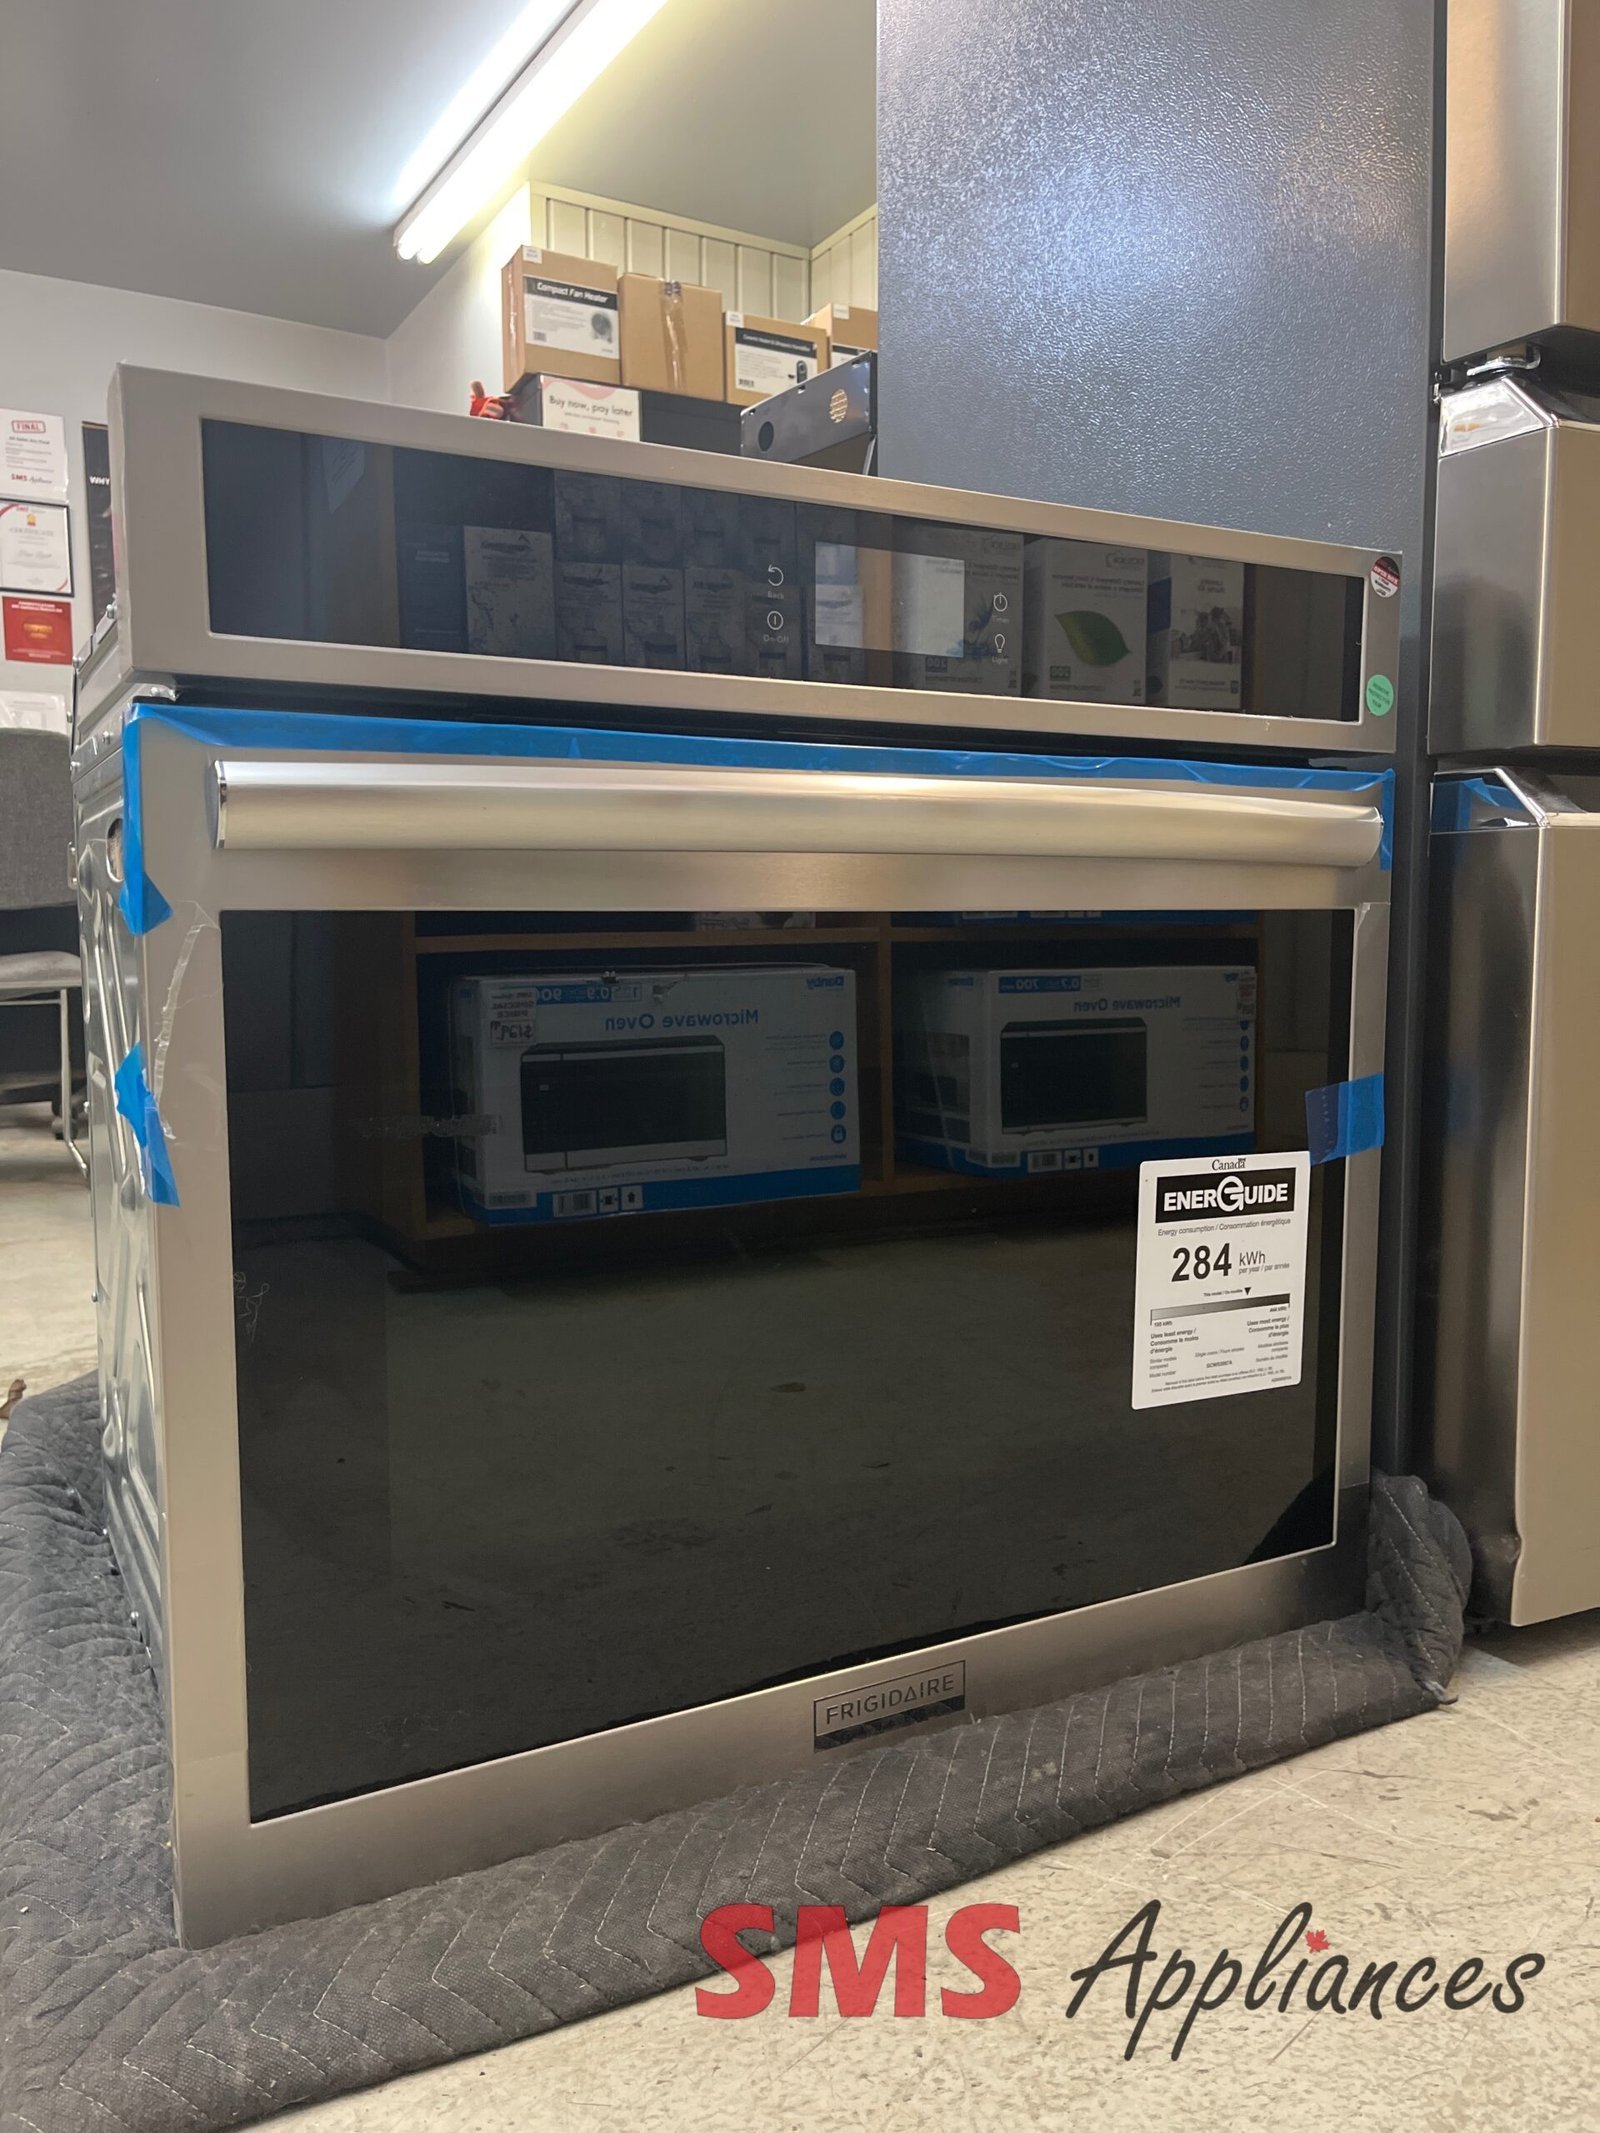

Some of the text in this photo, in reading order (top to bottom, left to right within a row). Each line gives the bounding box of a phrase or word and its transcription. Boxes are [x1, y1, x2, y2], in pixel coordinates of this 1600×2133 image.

[537, 282, 609, 303] Compact Fan Heater
[549, 395, 633, 416] Buy now, pay later
[768, 591, 785, 600] Back
[992, 657, 1009, 666] Light
[1211, 1158, 1246, 1171] Canada
[1163, 1175, 1289, 1213] ENERGUIDE
[1157, 1228, 1178, 1237] Energy
[1178, 1225, 1215, 1234] consumption
[1219, 1220, 1260, 1231] Consommation
[1260, 1217, 1291, 1228] énergétique
[1171, 1243, 1266, 1282] 284 kWh
[1238, 1267, 1248, 1275] per
[826, 1674, 955, 1725] FRIGIDAIRE
